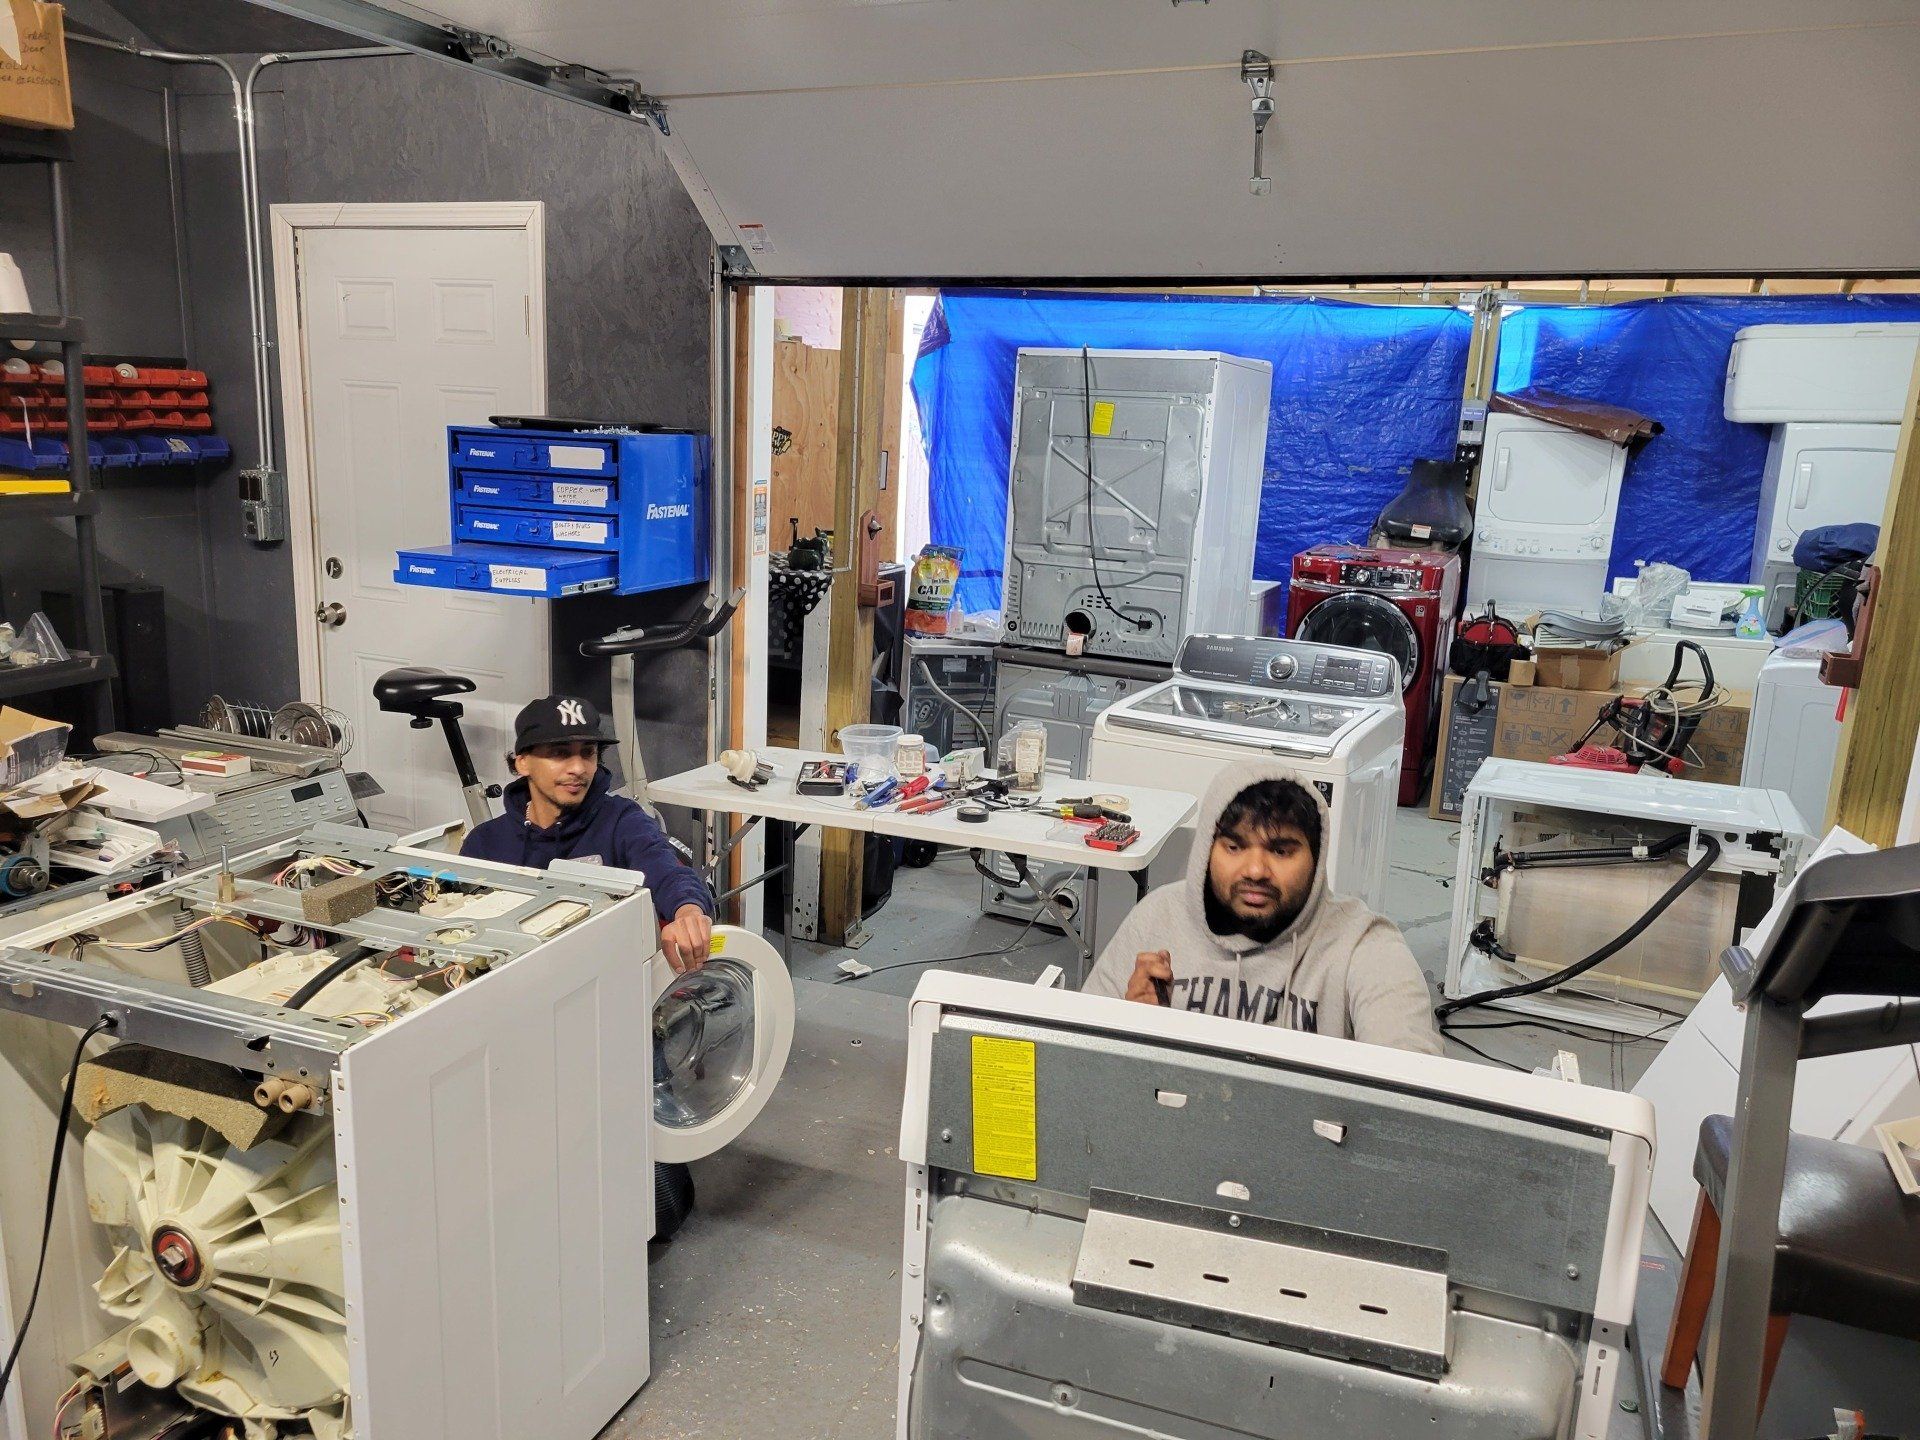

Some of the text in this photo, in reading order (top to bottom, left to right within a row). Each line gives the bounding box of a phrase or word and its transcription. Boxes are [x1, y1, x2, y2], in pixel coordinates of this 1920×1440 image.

[469, 448, 496, 458] FASTENAL
[473, 484, 500, 495] FASTENAL
[646, 503, 690, 520] FASTENAL
[473, 520, 500, 530] FASTENAL
[409, 564, 437, 575] FASTENAL
[1206, 644, 1234, 653] SAMSUNG
[556, 699, 587, 726] NY
